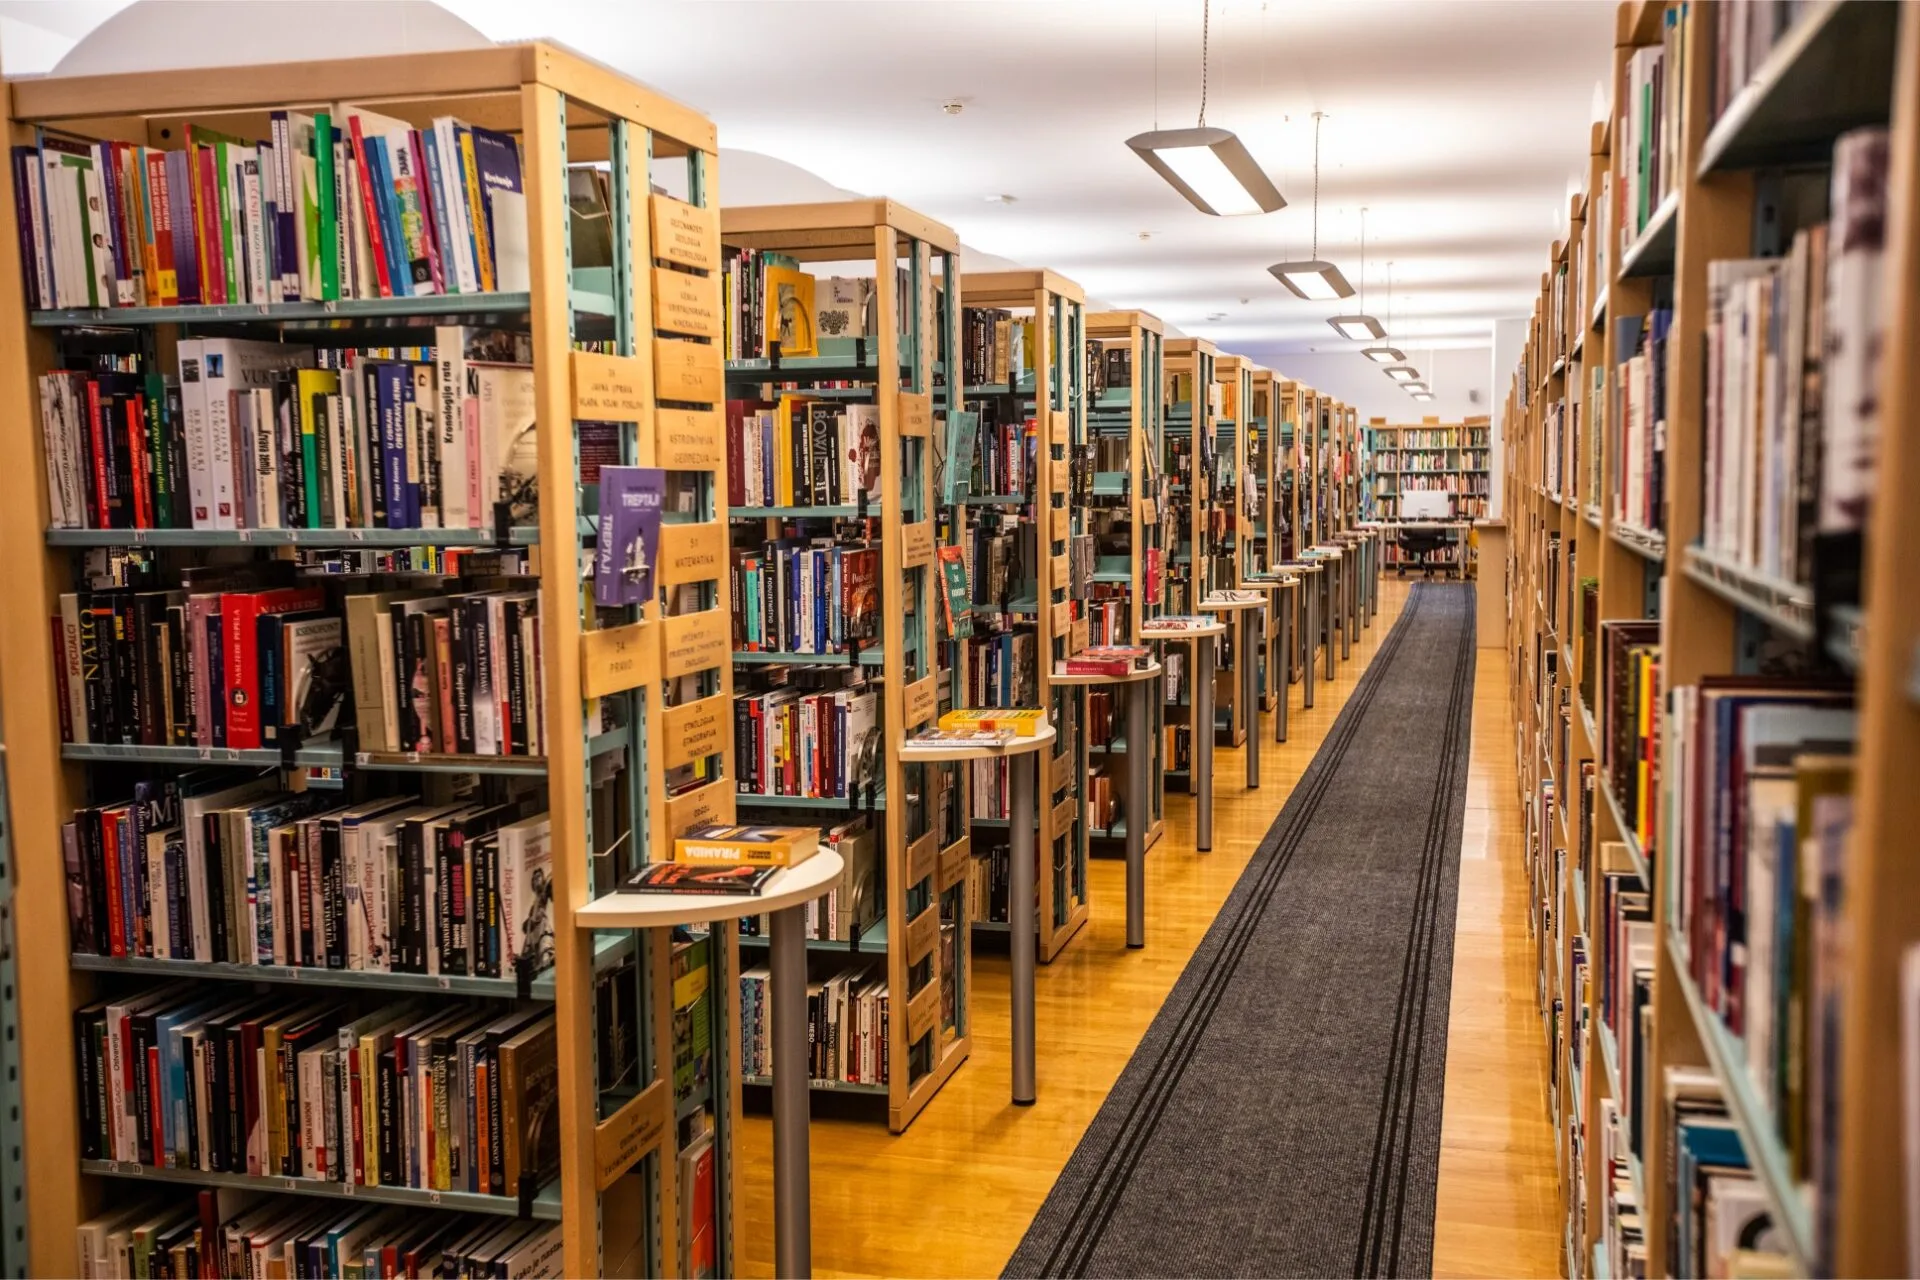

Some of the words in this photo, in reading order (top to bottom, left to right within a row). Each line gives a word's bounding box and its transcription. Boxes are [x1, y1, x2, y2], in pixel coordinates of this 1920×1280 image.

[813, 410, 827, 462] BOWIE
[622, 493, 659, 508] TREPTAJI
[600, 514, 613, 574] TREPTAJI
[80, 607, 99, 681] NATO
[684, 846, 740, 859] PIRAMIDA
[112, 1033, 120, 1071] Ostvarenja
